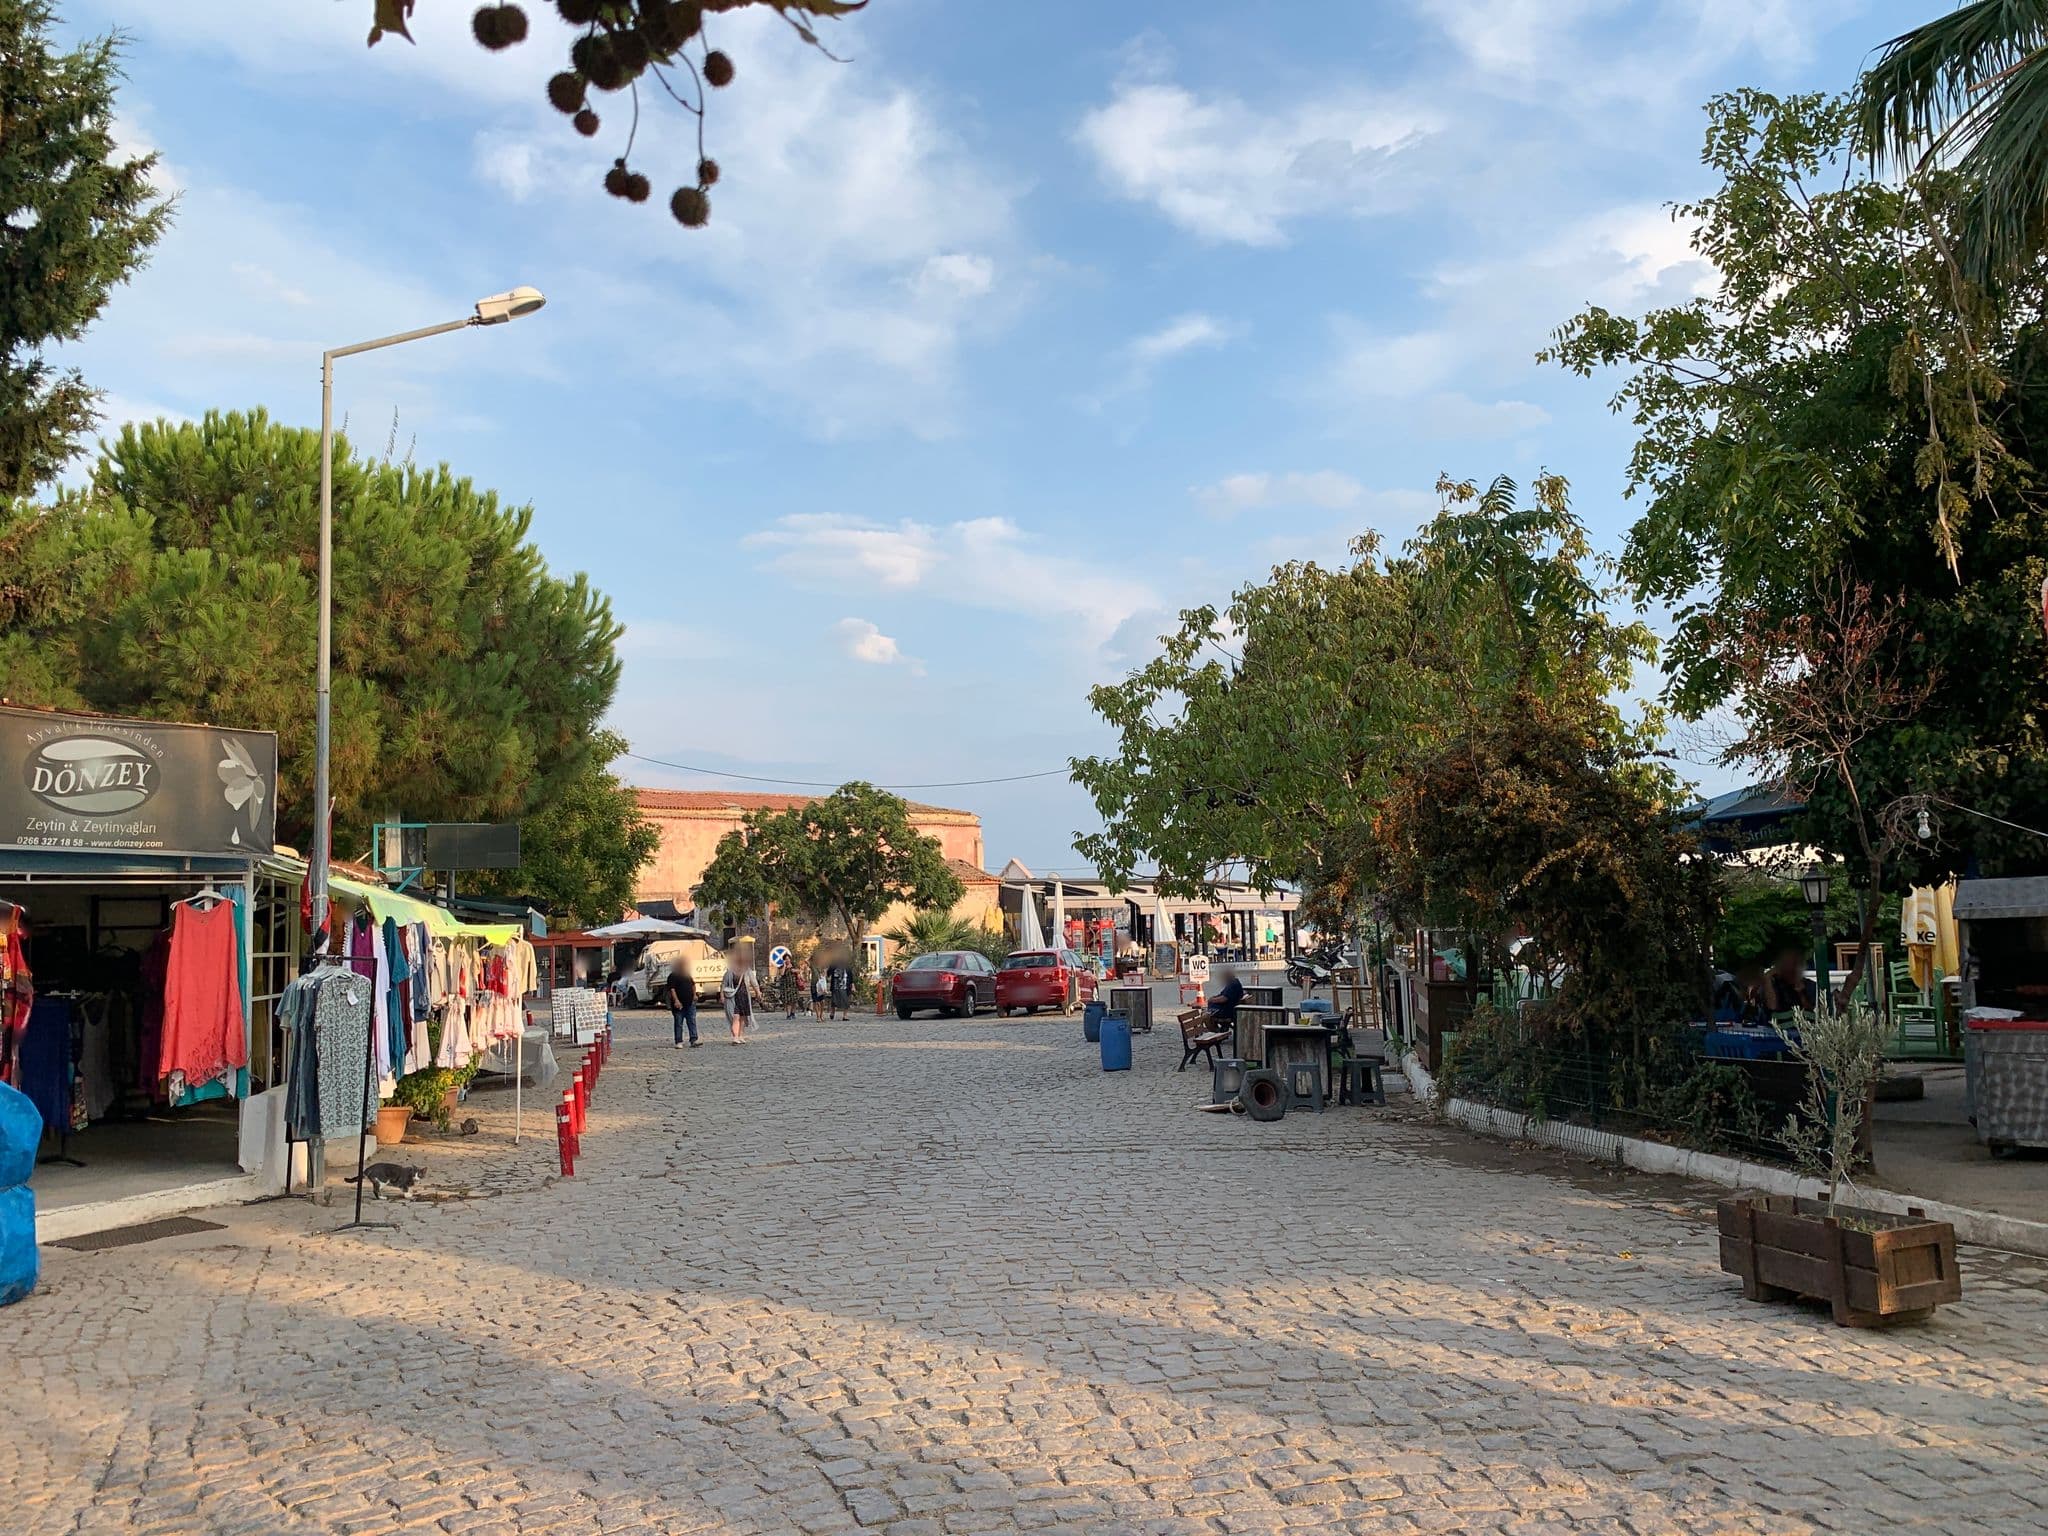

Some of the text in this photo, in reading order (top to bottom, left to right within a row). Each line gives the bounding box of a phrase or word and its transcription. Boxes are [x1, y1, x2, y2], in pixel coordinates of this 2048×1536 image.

[31, 763, 152, 794] DÖNZEY
[26, 817, 157, 836] Zeytin & Zeytinyağları
[16, 836, 39, 846] 0266
[41, 837, 58, 846] 327
[61, 838, 71, 847] 18
[72, 838, 84, 847] 58
[91, 839, 164, 848] www.donzey.com
[1192, 960, 1206, 970] WC
